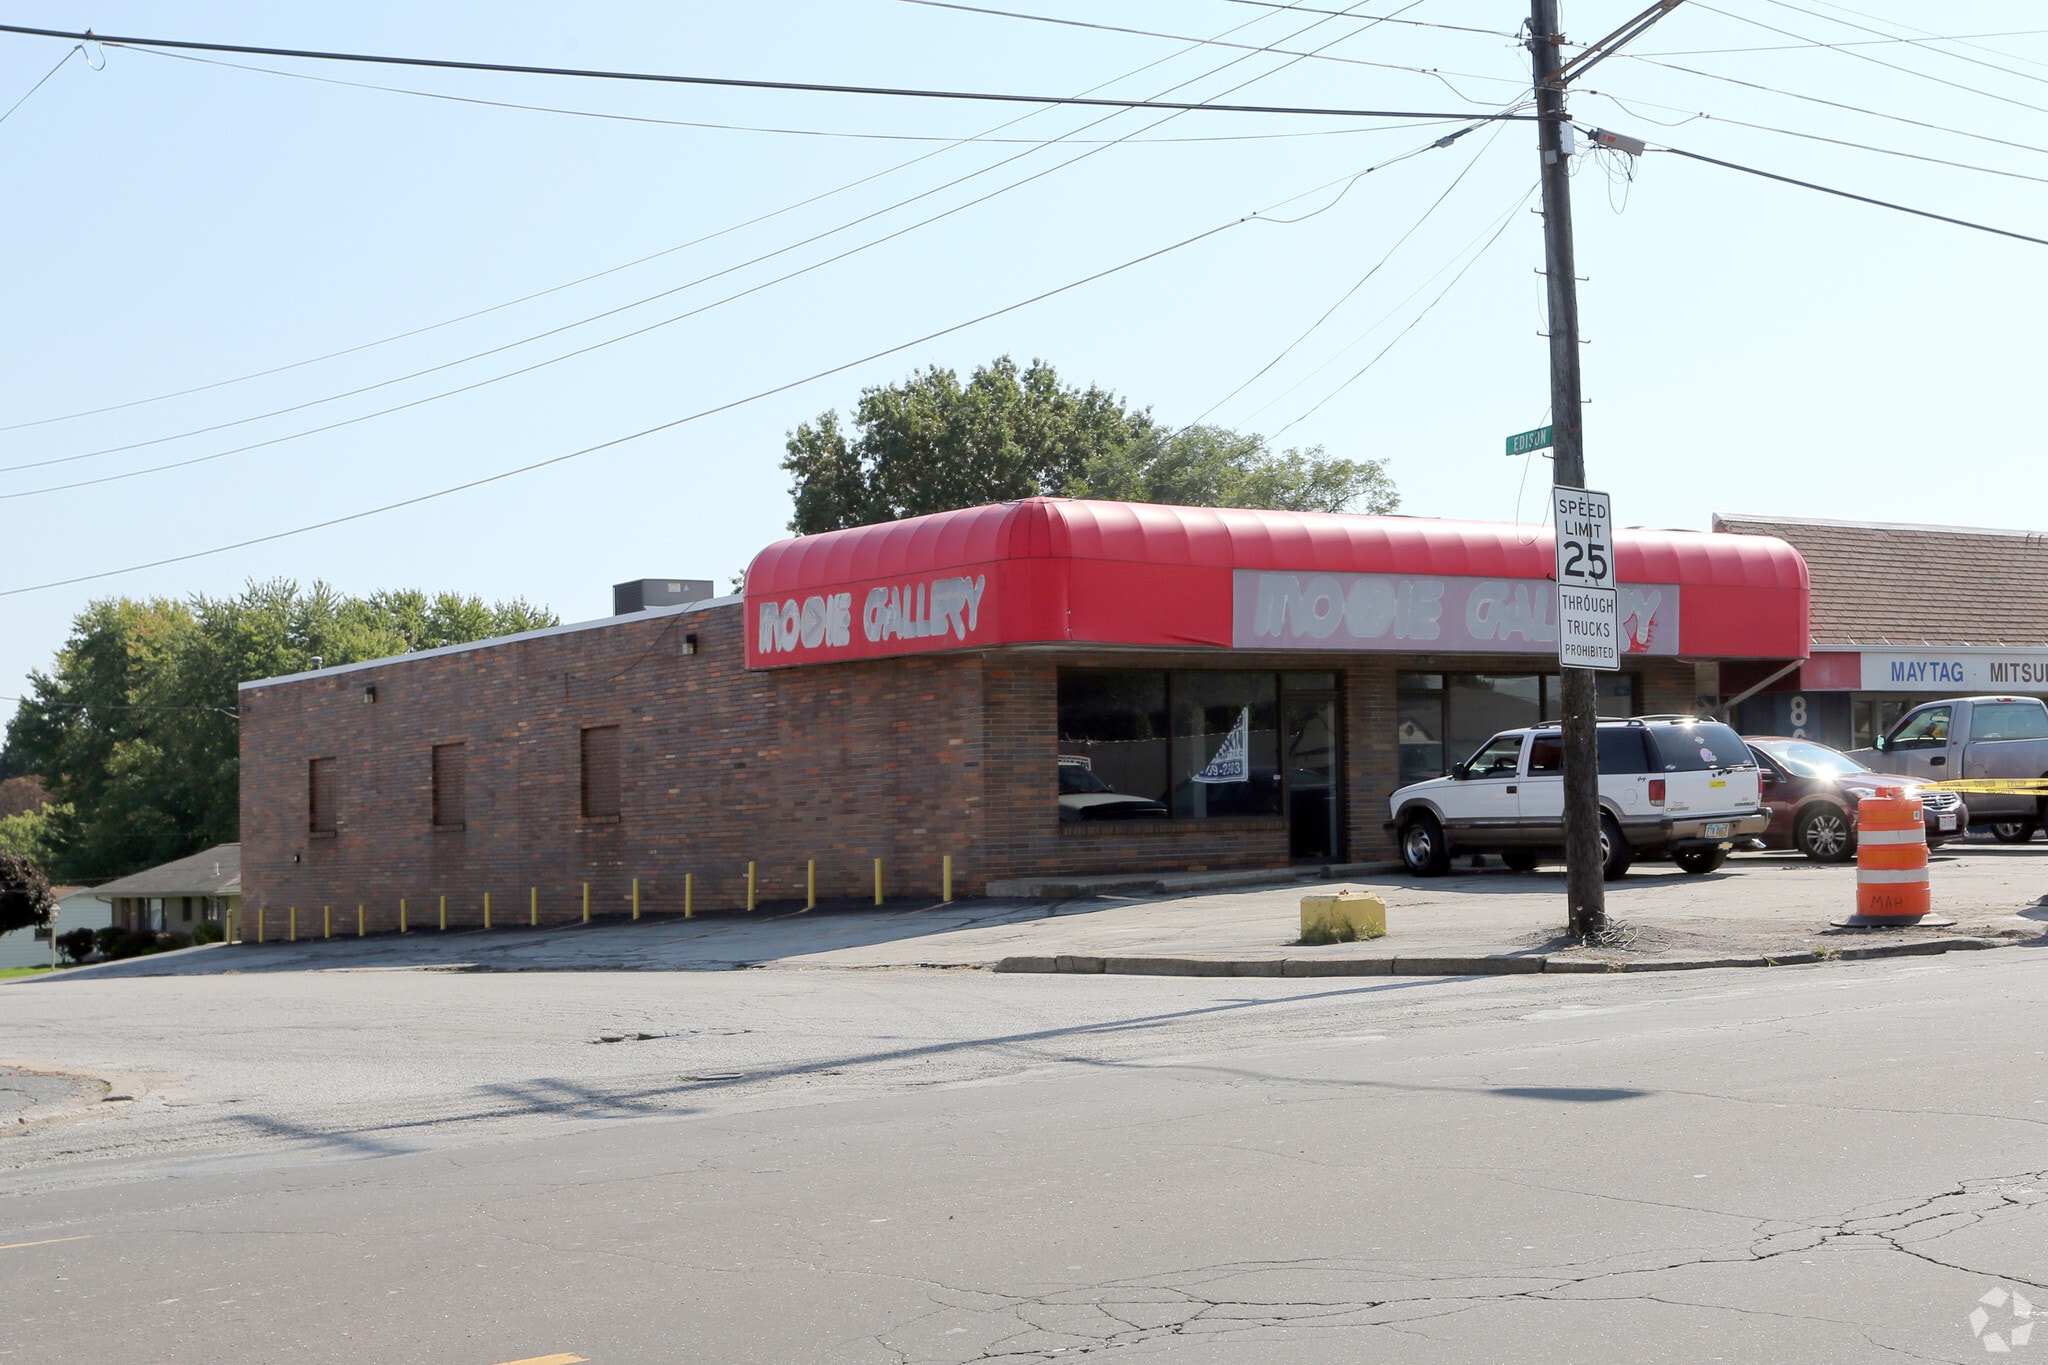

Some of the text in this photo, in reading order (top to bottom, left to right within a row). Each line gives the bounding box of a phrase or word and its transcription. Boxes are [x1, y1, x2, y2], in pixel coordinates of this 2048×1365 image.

[1513, 429, 1547, 451] EDISON
[1559, 499, 1606, 518] SPEED
[1564, 520, 1601, 538] LIMIT
[1563, 540, 1608, 580] 25
[1562, 594, 1613, 614] THROUGH
[1567, 619, 1610, 638] TRUCKS
[1565, 644, 1614, 659] PROHIBITED
[1890, 661, 2048, 683] MAYTAG MITSU
